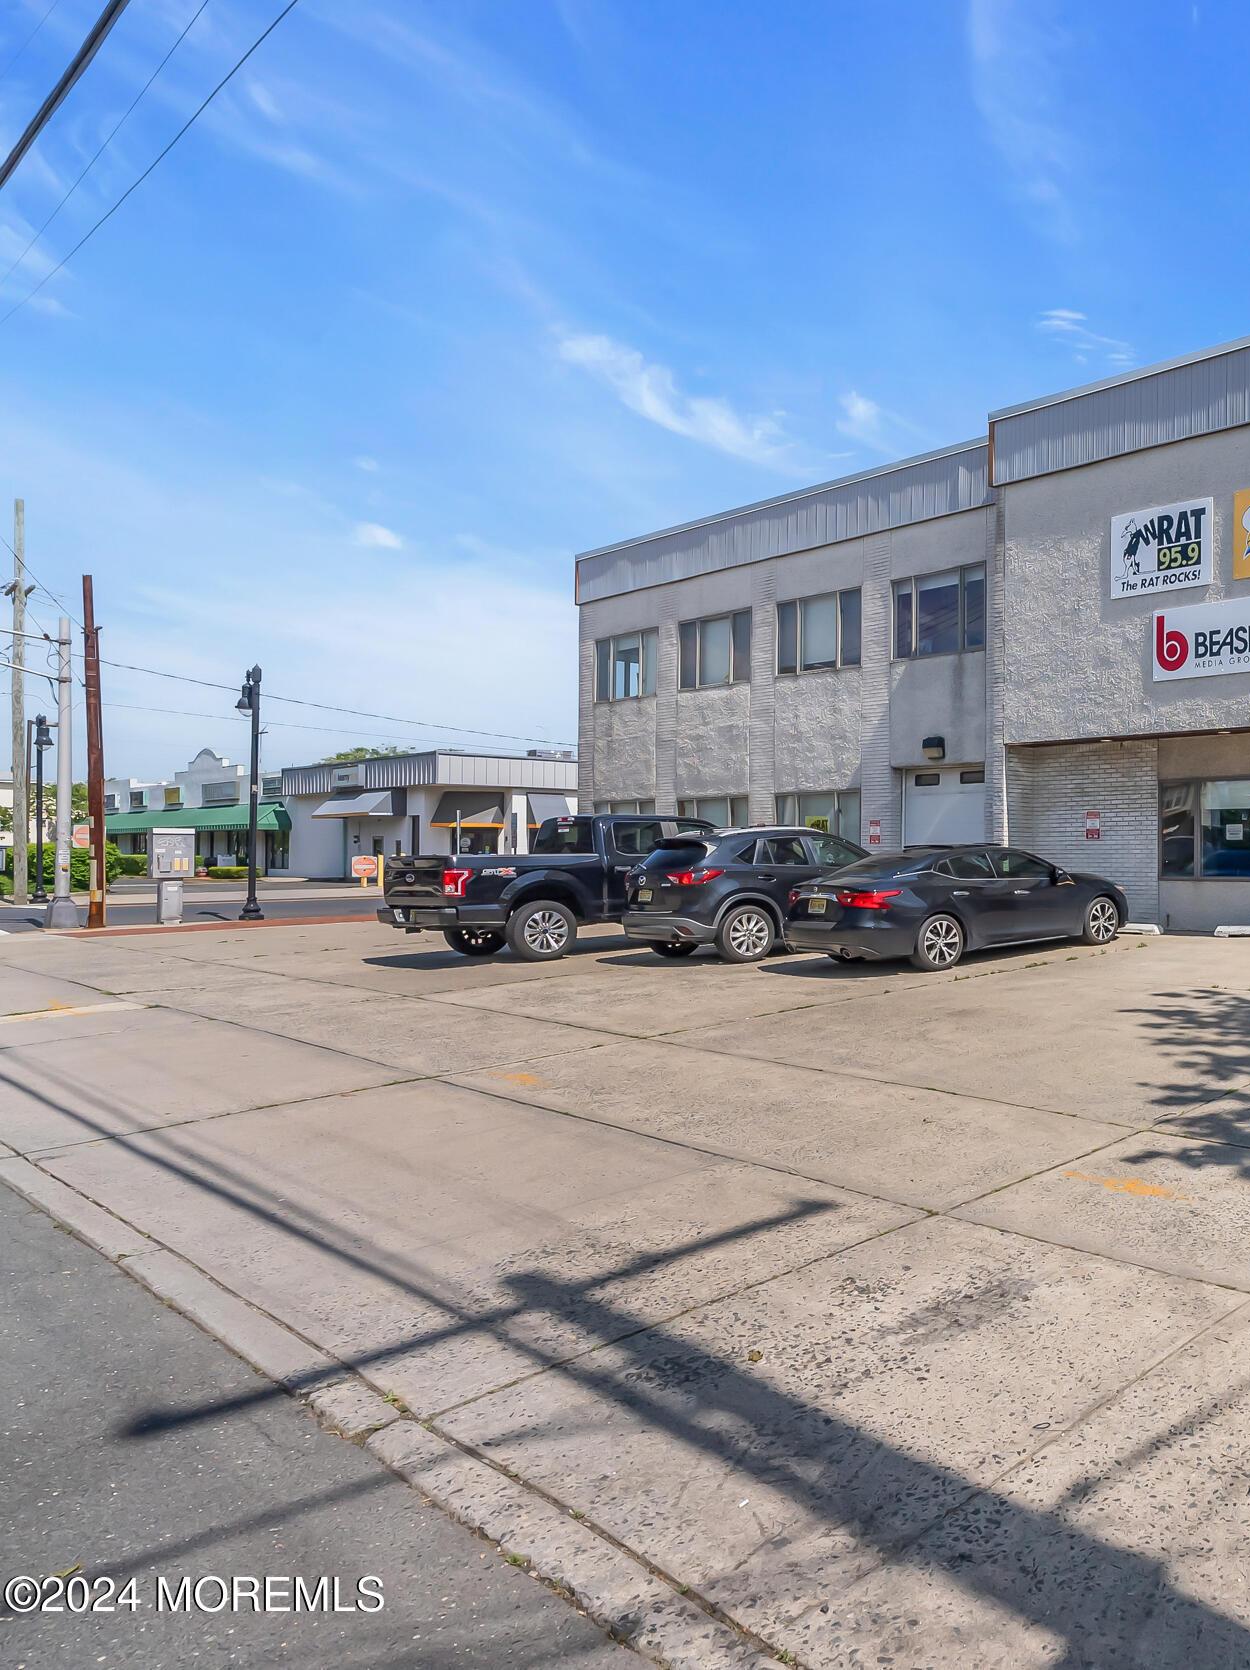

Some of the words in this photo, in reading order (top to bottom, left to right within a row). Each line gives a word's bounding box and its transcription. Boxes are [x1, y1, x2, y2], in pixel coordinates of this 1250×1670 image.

[1159, 543, 1200, 570] 95.9
[1121, 580, 1138, 592] The
[1140, 576, 1160, 589] RAT
[1162, 569, 1201, 586] ROCKS!
[1194, 659, 1223, 669] MEDIA
